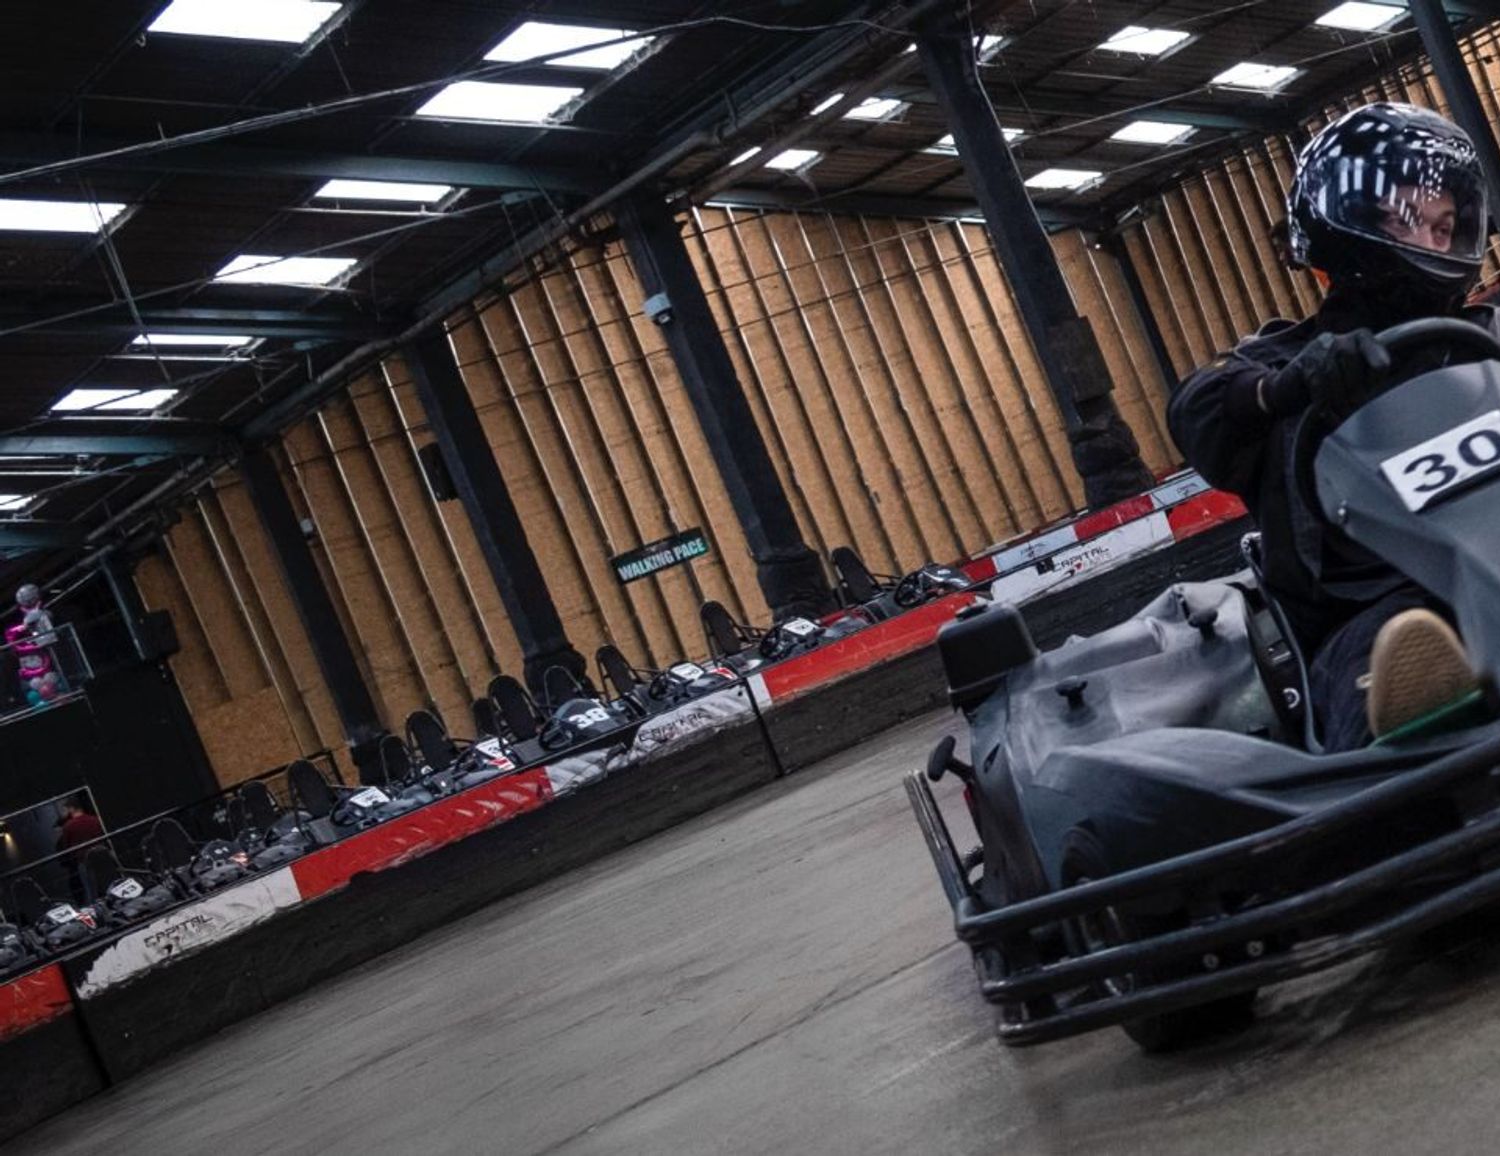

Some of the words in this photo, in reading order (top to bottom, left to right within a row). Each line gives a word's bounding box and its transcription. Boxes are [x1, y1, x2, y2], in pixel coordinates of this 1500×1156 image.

[618, 550, 675, 581] WALKING
[672, 538, 706, 560] PACE
[569, 708, 610, 729] 38
